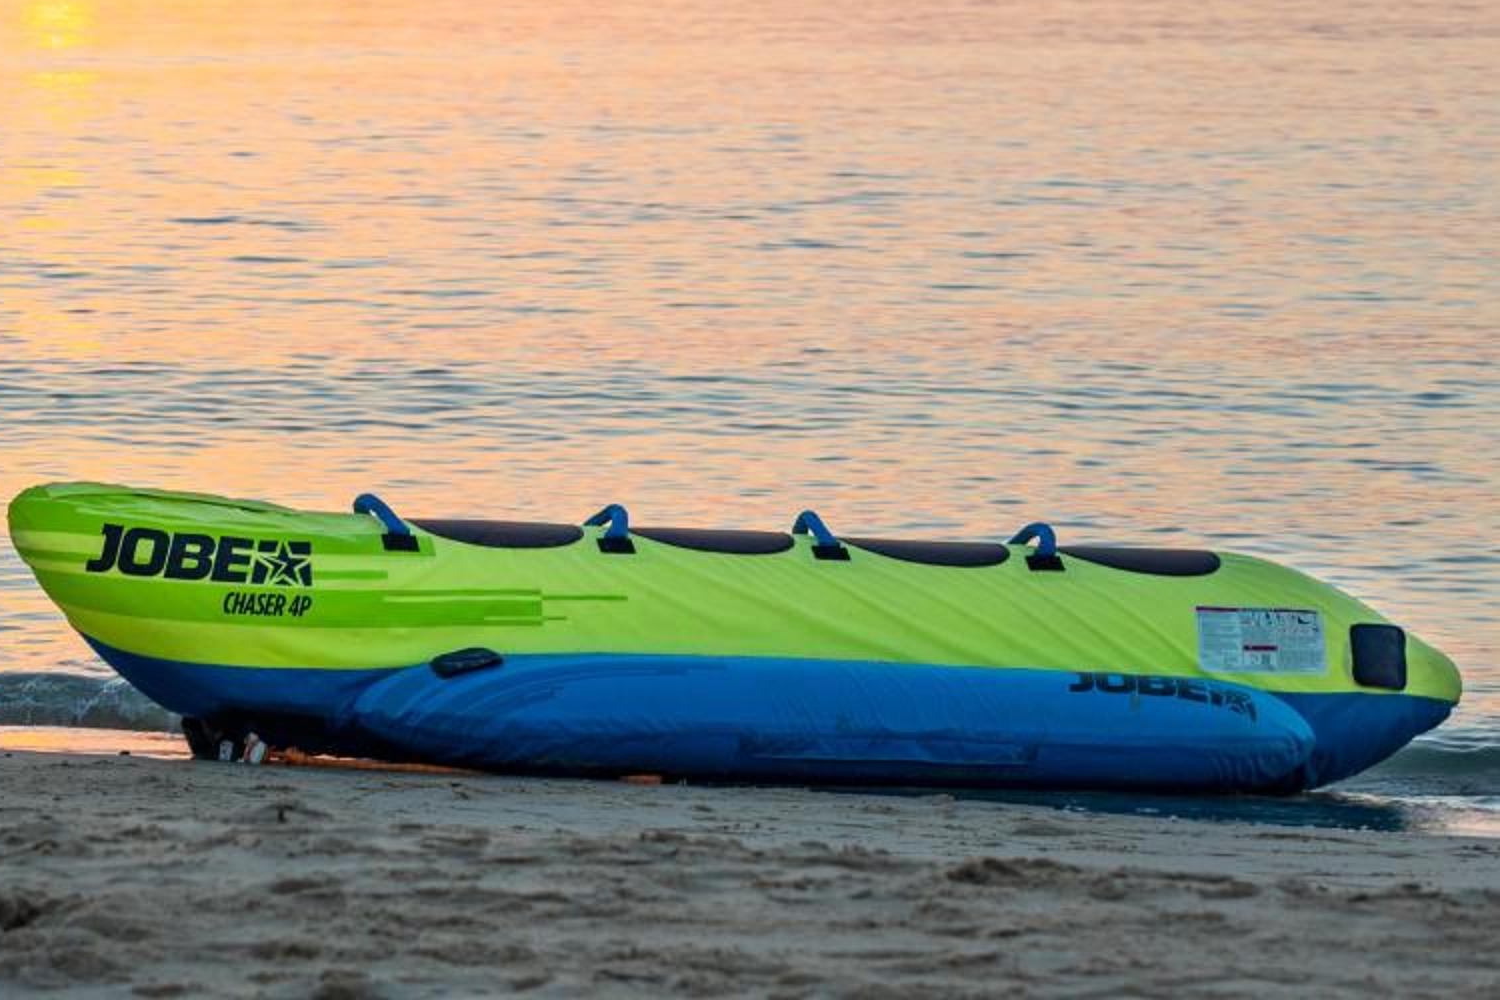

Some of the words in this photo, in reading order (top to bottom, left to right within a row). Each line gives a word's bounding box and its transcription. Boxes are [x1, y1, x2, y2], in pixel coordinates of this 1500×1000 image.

[86, 524, 254, 583] JOBE
[223, 591, 285, 616] CHASER
[288, 596, 311, 616] 4P
